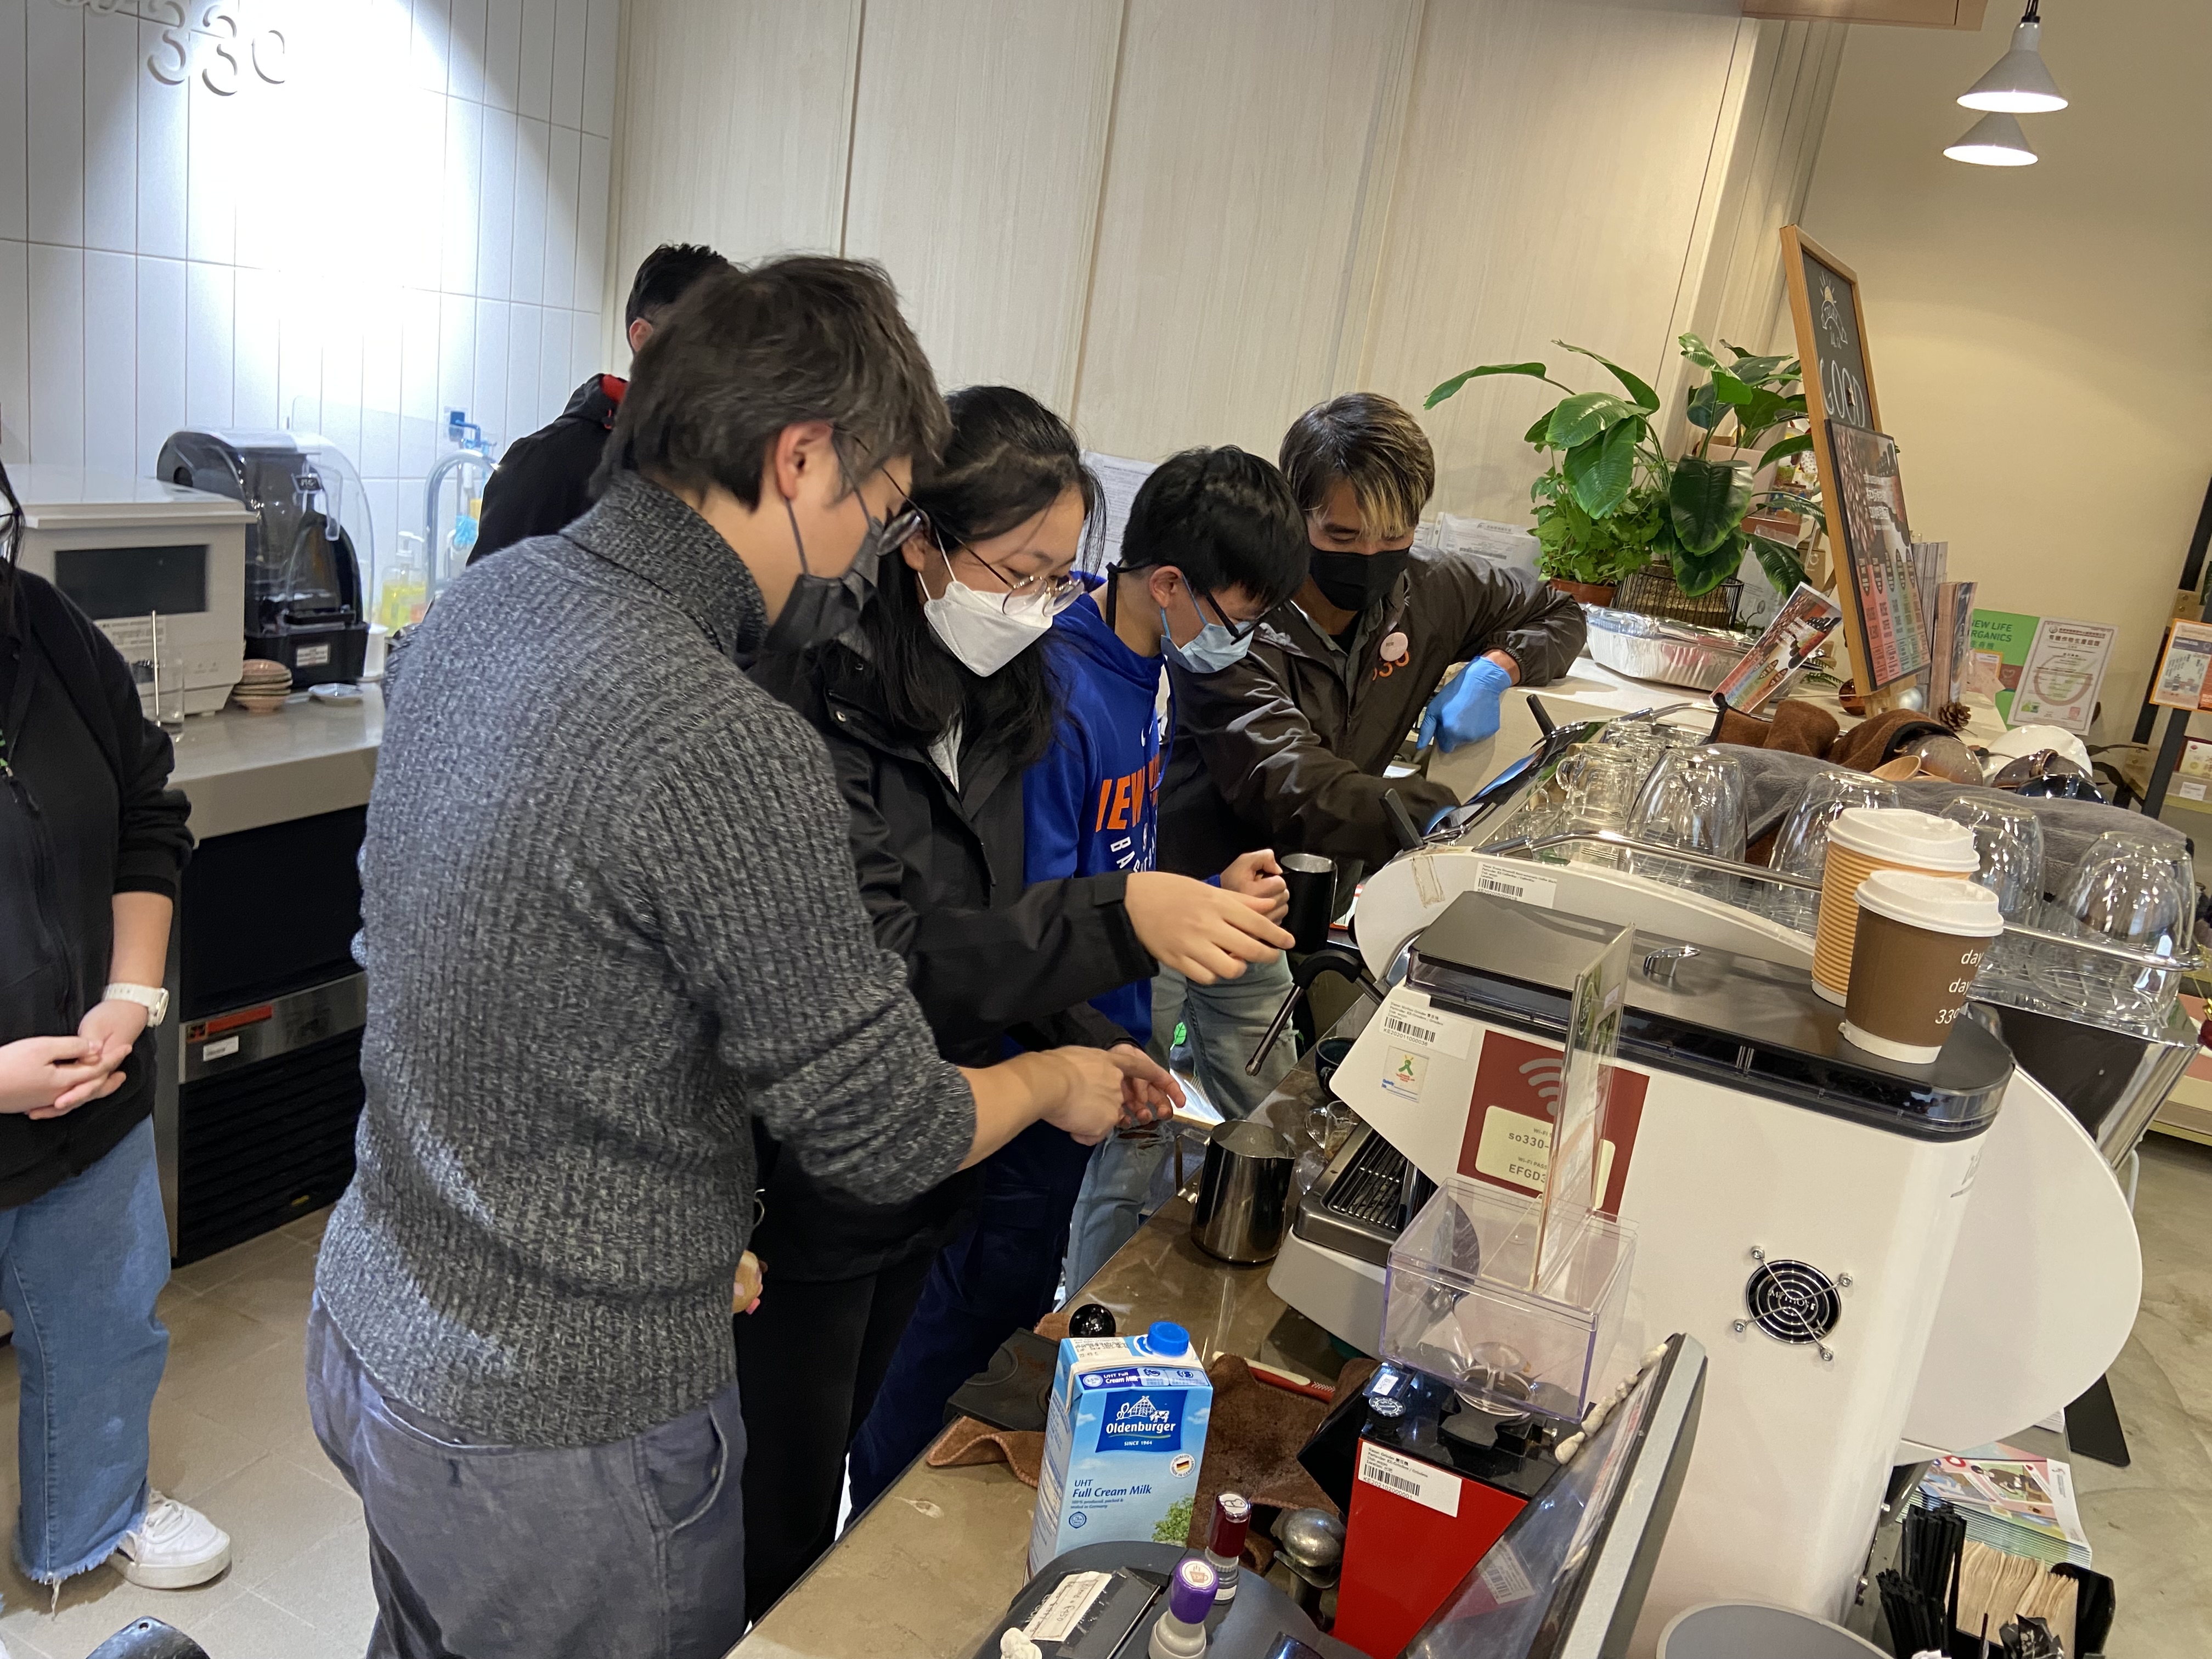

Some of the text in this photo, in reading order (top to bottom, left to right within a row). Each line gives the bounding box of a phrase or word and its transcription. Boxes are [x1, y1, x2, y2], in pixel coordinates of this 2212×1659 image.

[1820, 357, 1865, 428] GOOD
[1991, 622, 2013, 632] LIFE
[1971, 630, 2013, 642] RGANICS
[1961, 949, 1984, 967] day
[1949, 978, 1973, 995] day
[1935, 1008, 1960, 1024] 330
[1106, 1421, 1176, 1434] Oldenburger
[1074, 1479, 1093, 1487] UHT
[1073, 1484, 1152, 1498] Full Cream Milk
